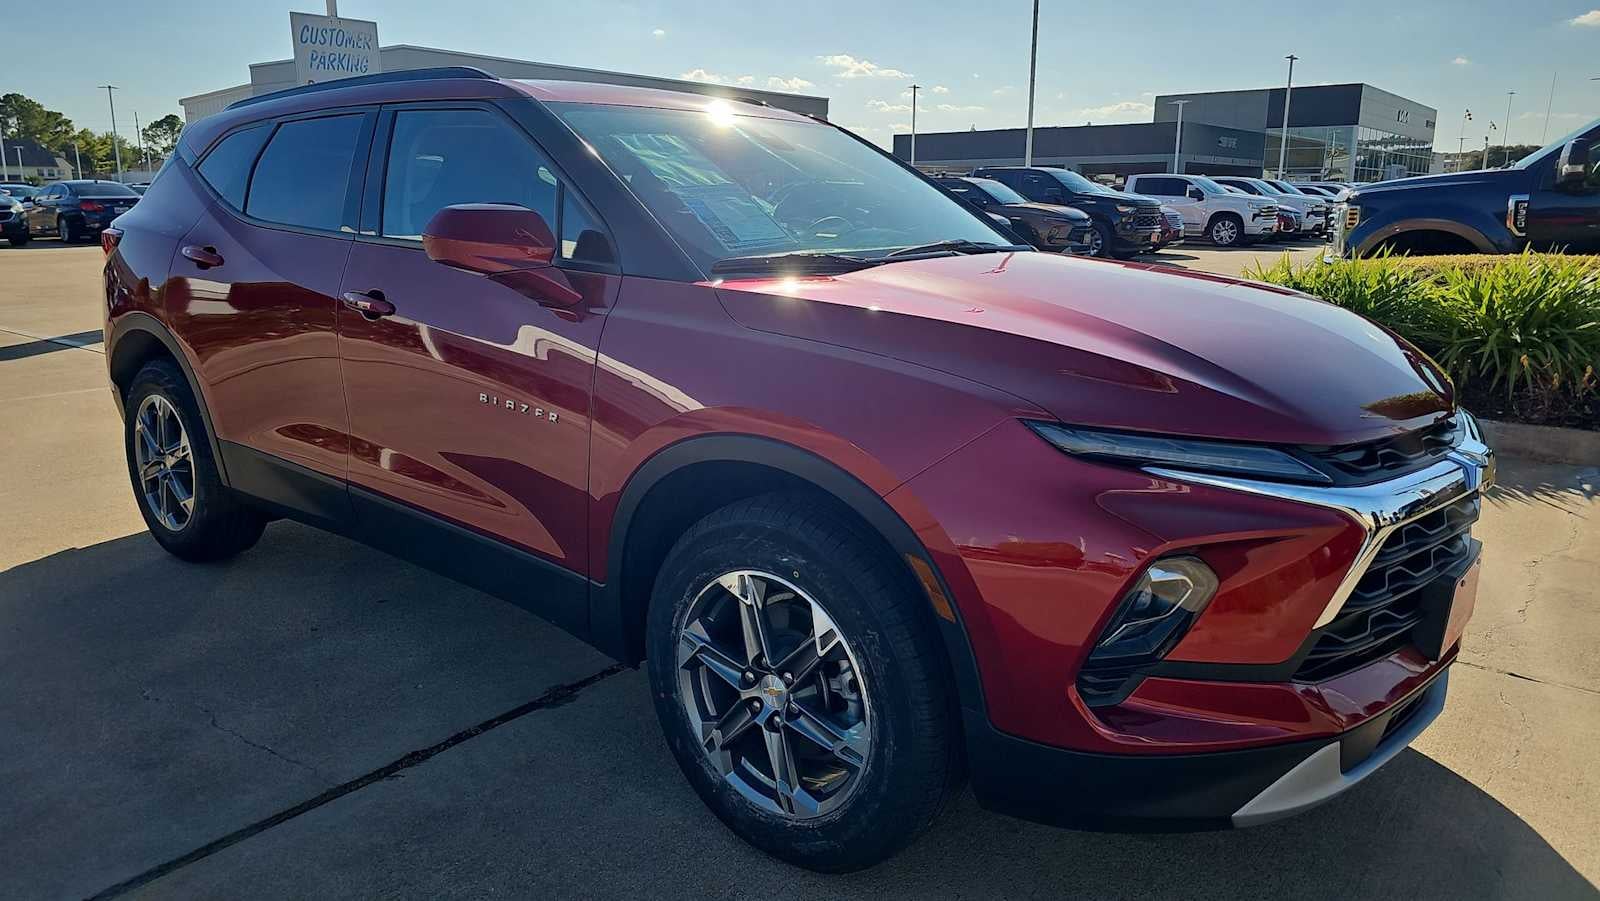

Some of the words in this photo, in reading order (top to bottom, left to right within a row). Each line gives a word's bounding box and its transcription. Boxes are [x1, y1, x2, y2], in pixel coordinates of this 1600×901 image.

[300, 24, 372, 50] CUSTOMER
[309, 49, 369, 73] PARKING
[479, 392, 560, 424] BLAZER
